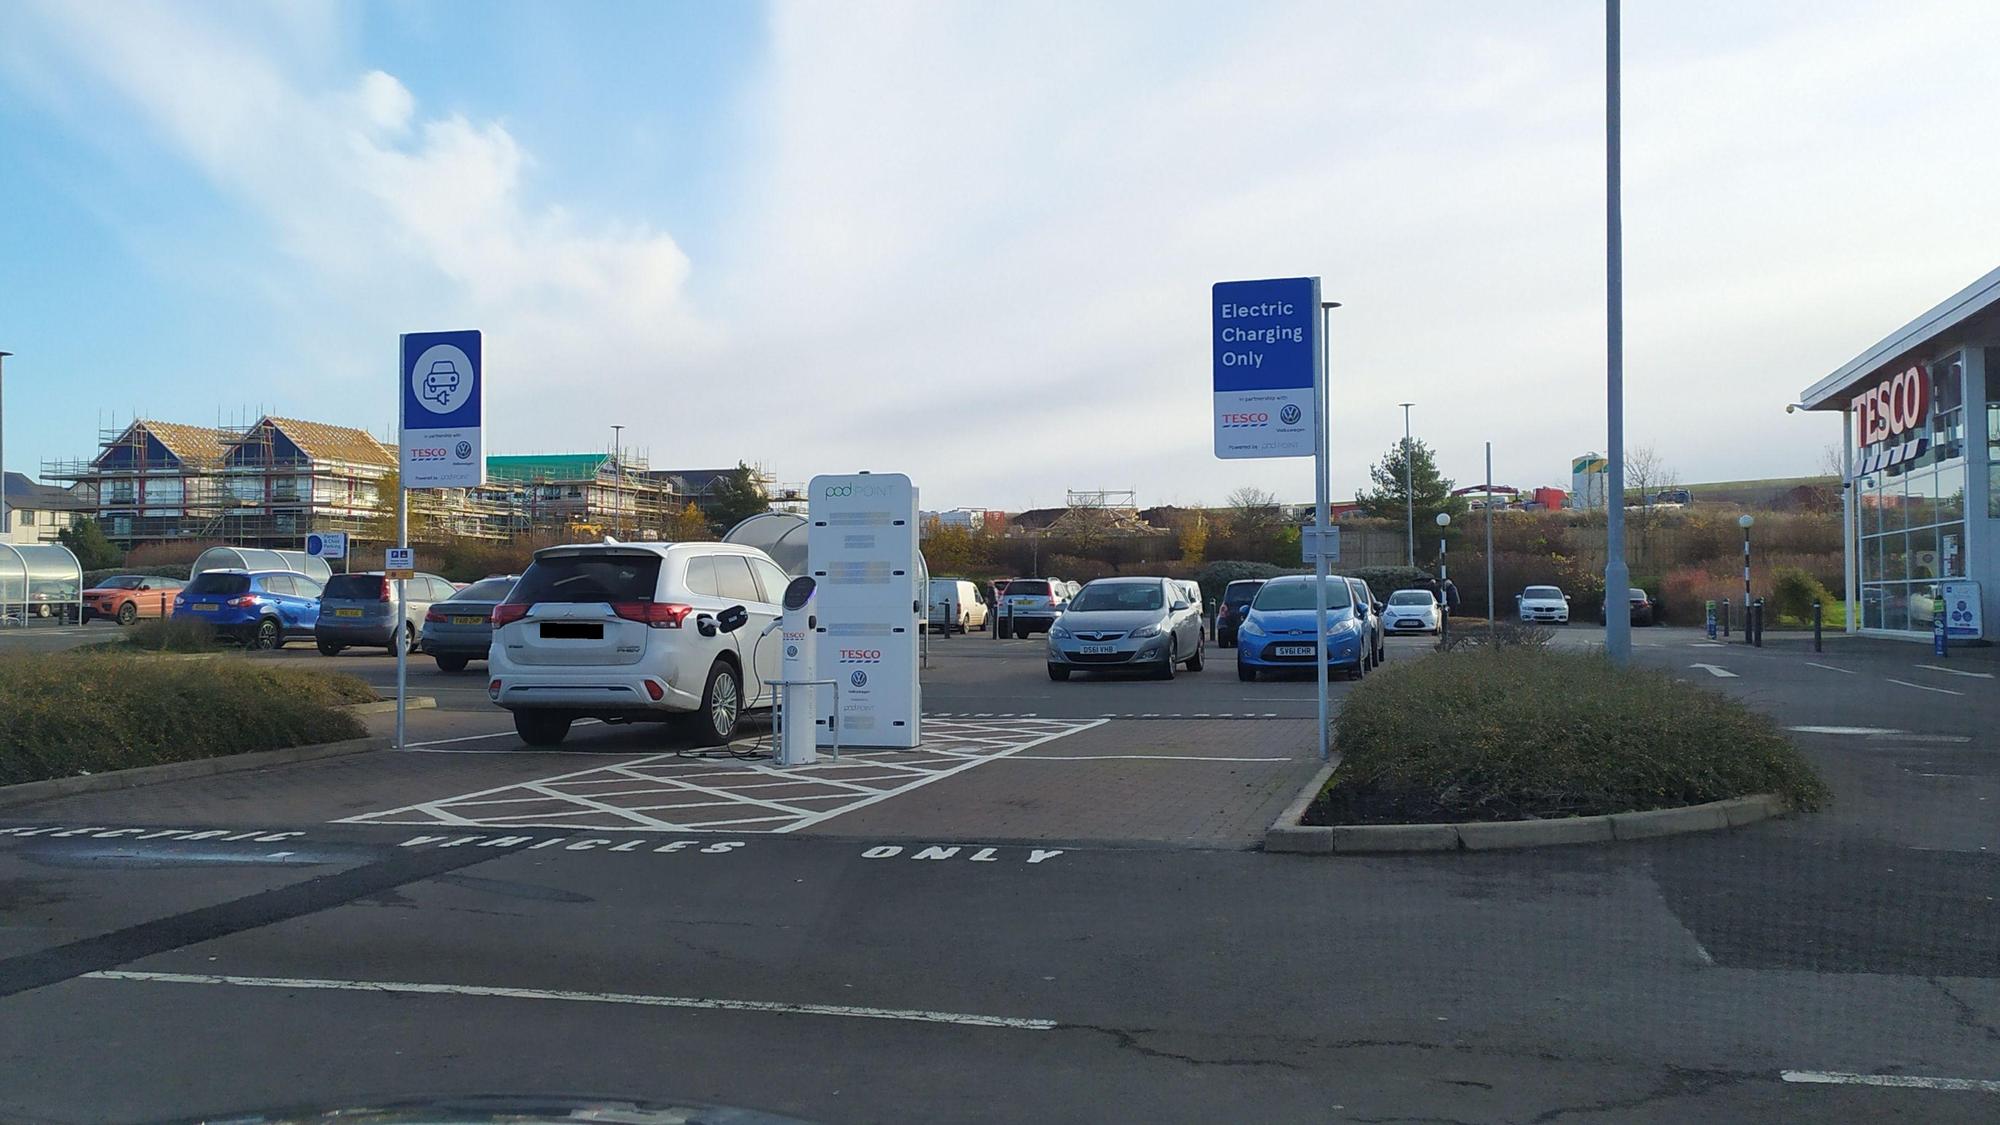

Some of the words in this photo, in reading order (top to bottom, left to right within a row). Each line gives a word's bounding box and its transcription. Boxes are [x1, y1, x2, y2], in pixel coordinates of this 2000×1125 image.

[1221, 301, 1294, 319] Electric
[1222, 325, 1303, 344] Charging
[1222, 351, 1264, 369] Only
[1851, 366, 1921, 448] TESCO
[1222, 412, 1269, 424] TESCO
[411, 448, 447, 457] TESCO
[840, 650, 881, 659] TESCO
[397, 836, 747, 854] VEHICLES
[860, 845, 1064, 864] ONLY
